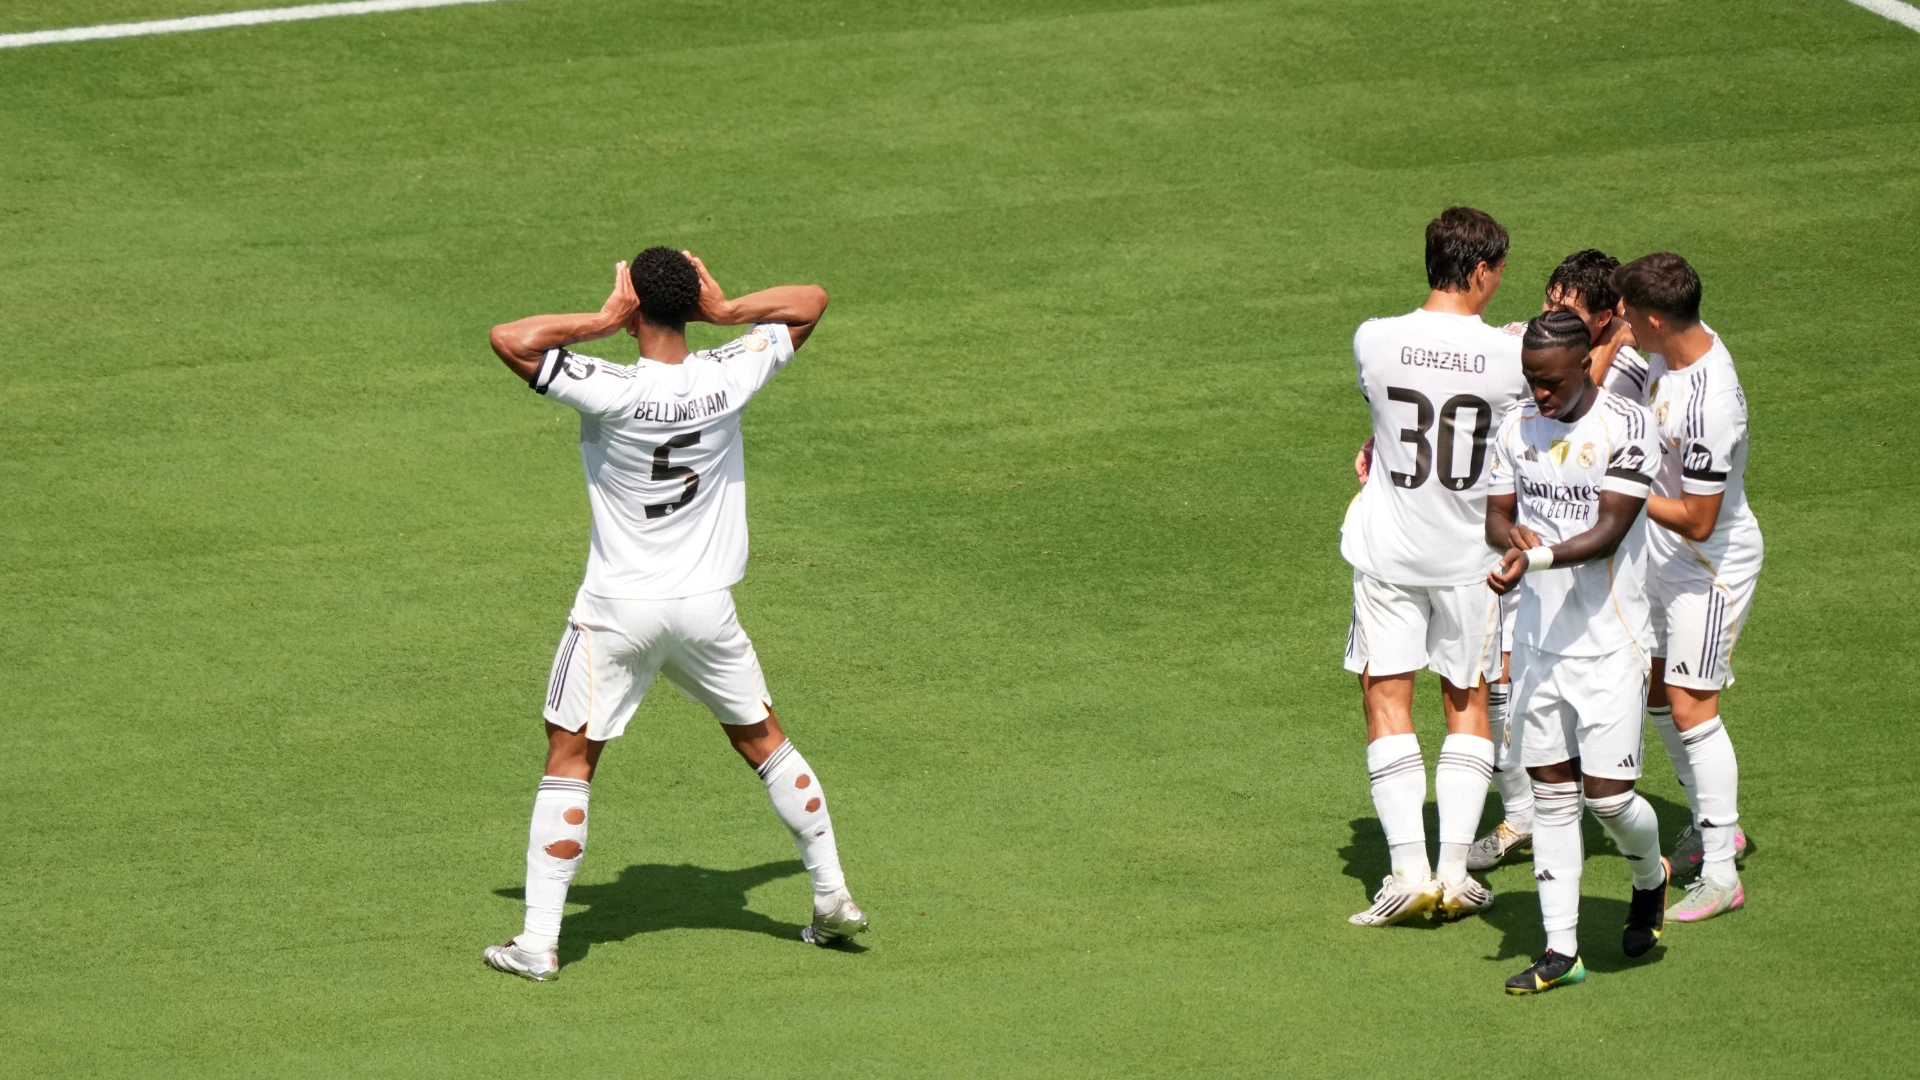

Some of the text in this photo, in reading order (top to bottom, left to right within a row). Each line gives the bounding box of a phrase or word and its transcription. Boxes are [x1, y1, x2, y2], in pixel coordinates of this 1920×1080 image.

[1400, 345, 1486, 374] GONZALO
[633, 390, 729, 423] BELLINGHAM
[1387, 386, 1492, 492] 30
[644, 430, 702, 519] 5
[1520, 475, 1600, 502] Emirates
[1547, 501, 1590, 521] BETTER
